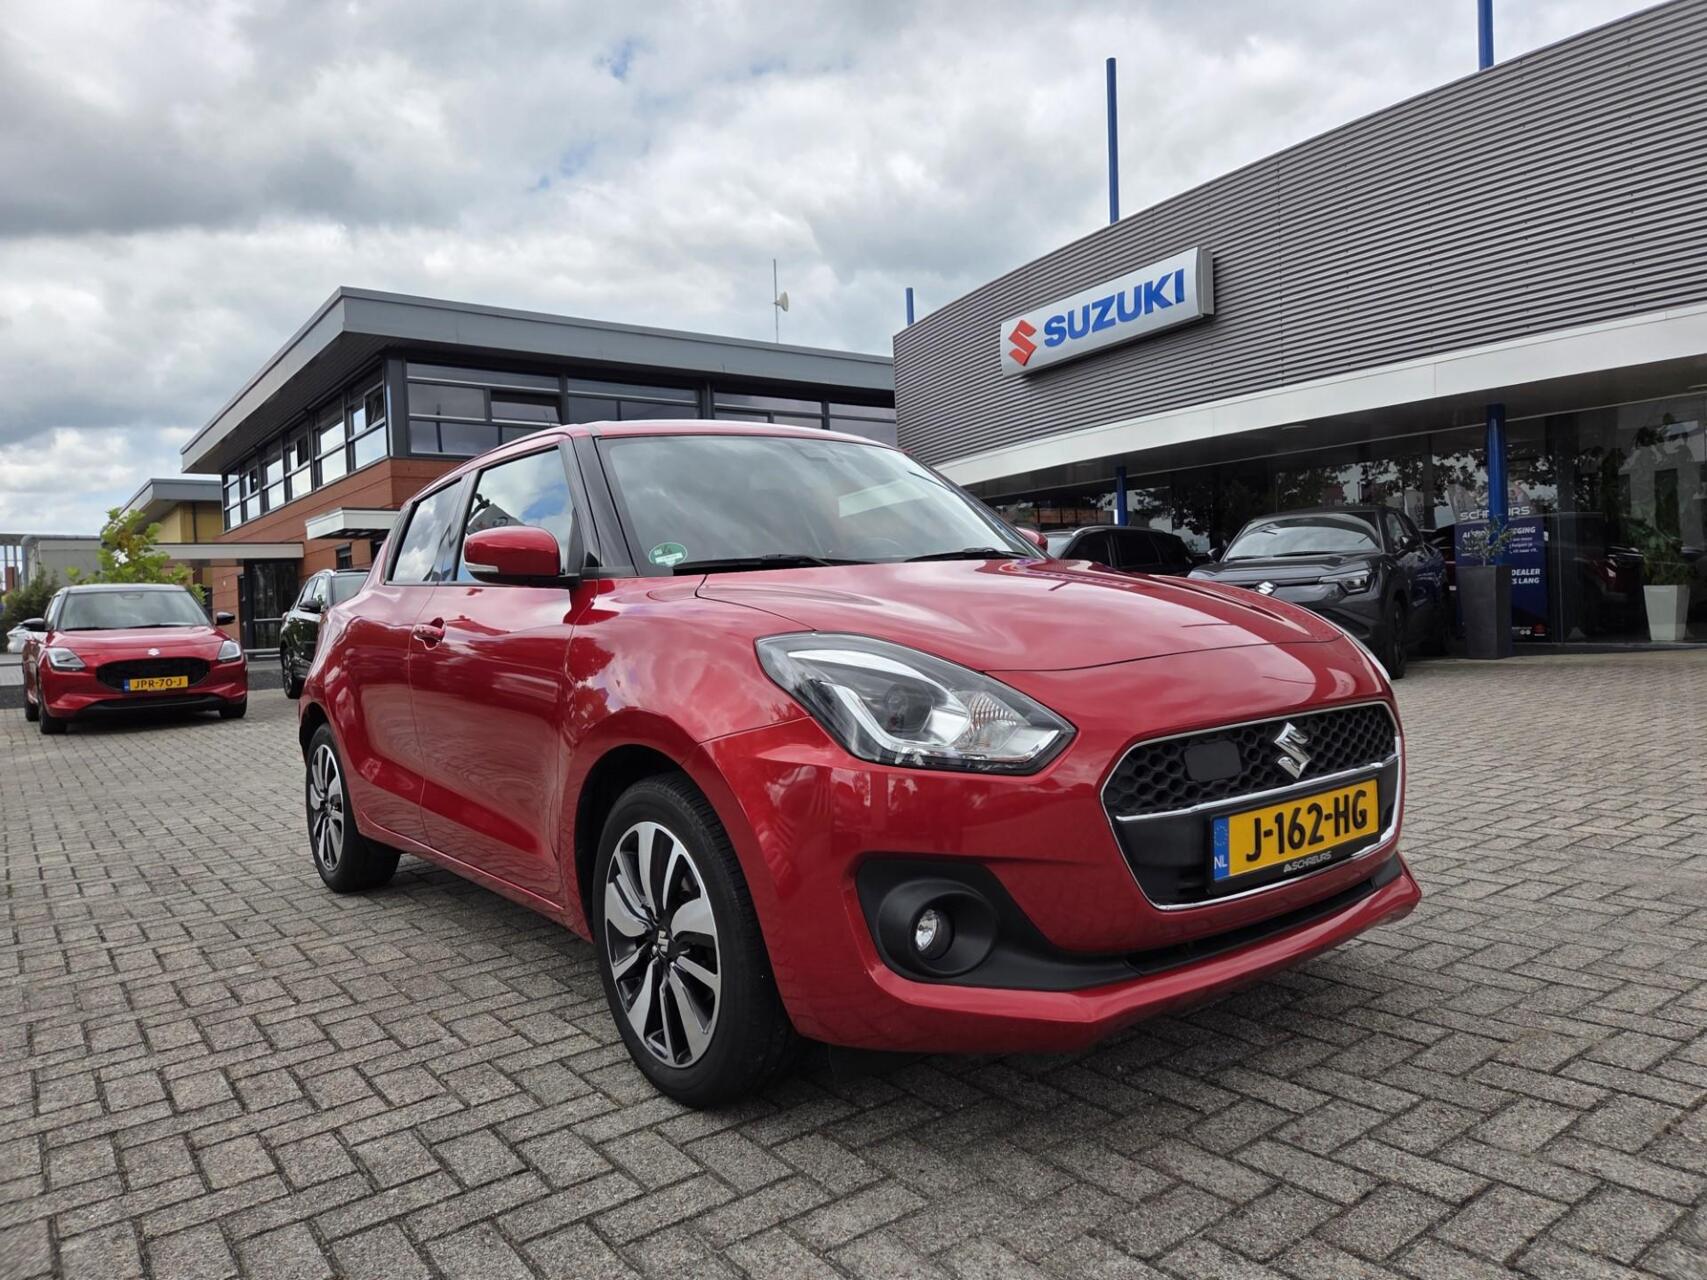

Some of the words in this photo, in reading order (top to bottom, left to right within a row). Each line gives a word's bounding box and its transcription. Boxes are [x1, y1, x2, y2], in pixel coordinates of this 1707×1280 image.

[1043, 268, 1185, 347] SUZUKI
[1511, 568, 1540, 576] DEALER
[133, 677, 183, 689] JPR-70-J
[1246, 789, 1368, 862] J-162-HG
[1213, 853, 1228, 869] NL
